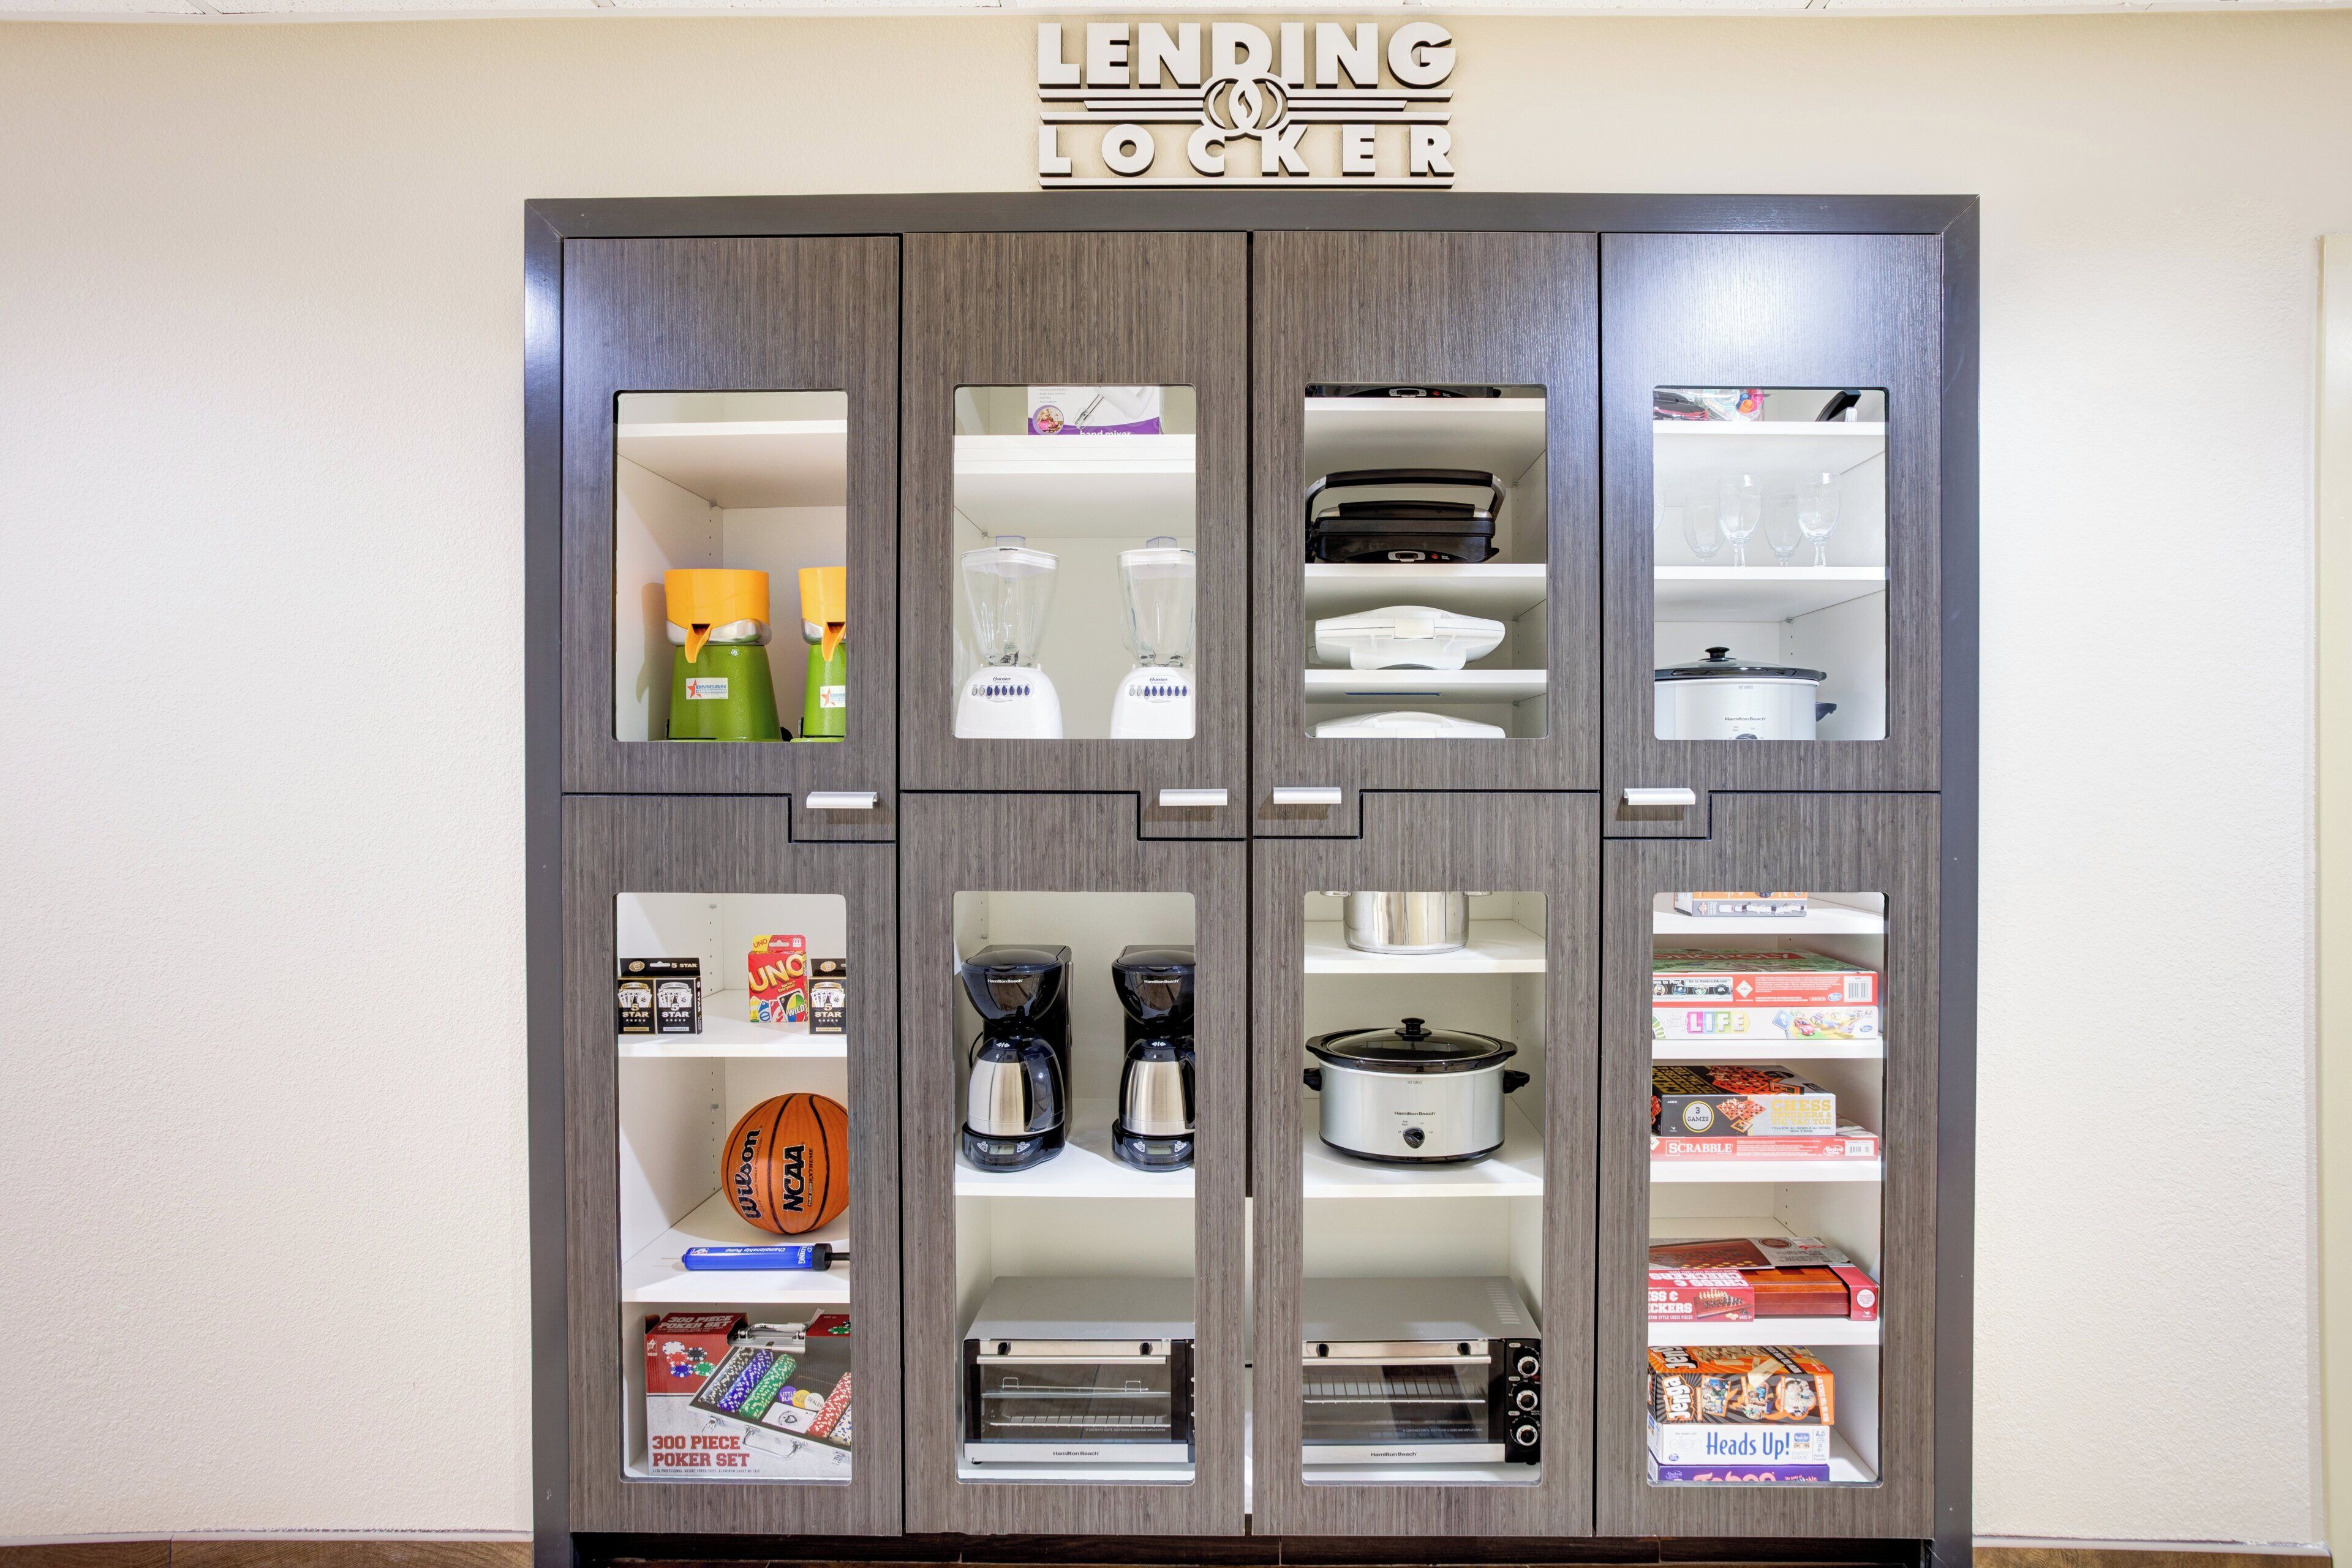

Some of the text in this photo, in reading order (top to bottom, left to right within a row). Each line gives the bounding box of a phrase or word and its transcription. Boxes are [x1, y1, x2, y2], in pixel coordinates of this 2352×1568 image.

[1038, 22, 1456, 88] LENDING
[1039, 124, 1455, 178] LOCKER
[753, 938, 767, 948] UNO
[748, 954, 804, 992] UNO
[631, 1003, 639, 1011] 5
[671, 1003, 680, 1011] 5
[787, 1005, 805, 1016] WILD
[823, 1003, 832, 1011] 5
[1691, 1013, 1744, 1032] LIFE
[1771, 1099, 1831, 1111] CHESS
[1668, 1142, 1733, 1153] SCRABBLE
[735, 1128, 762, 1219] Wilson
[783, 1144, 805, 1213] NCAA
[797, 1246, 807, 1264] LDING
[807, 1396, 823, 1408] DEALER
[1664, 1377, 1692, 1419] Jenga
[652, 1436, 740, 1449] 300 PIECE
[1706, 1432, 1790, 1460] Heads Up!
[653, 1453, 750, 1467] POKER SET
